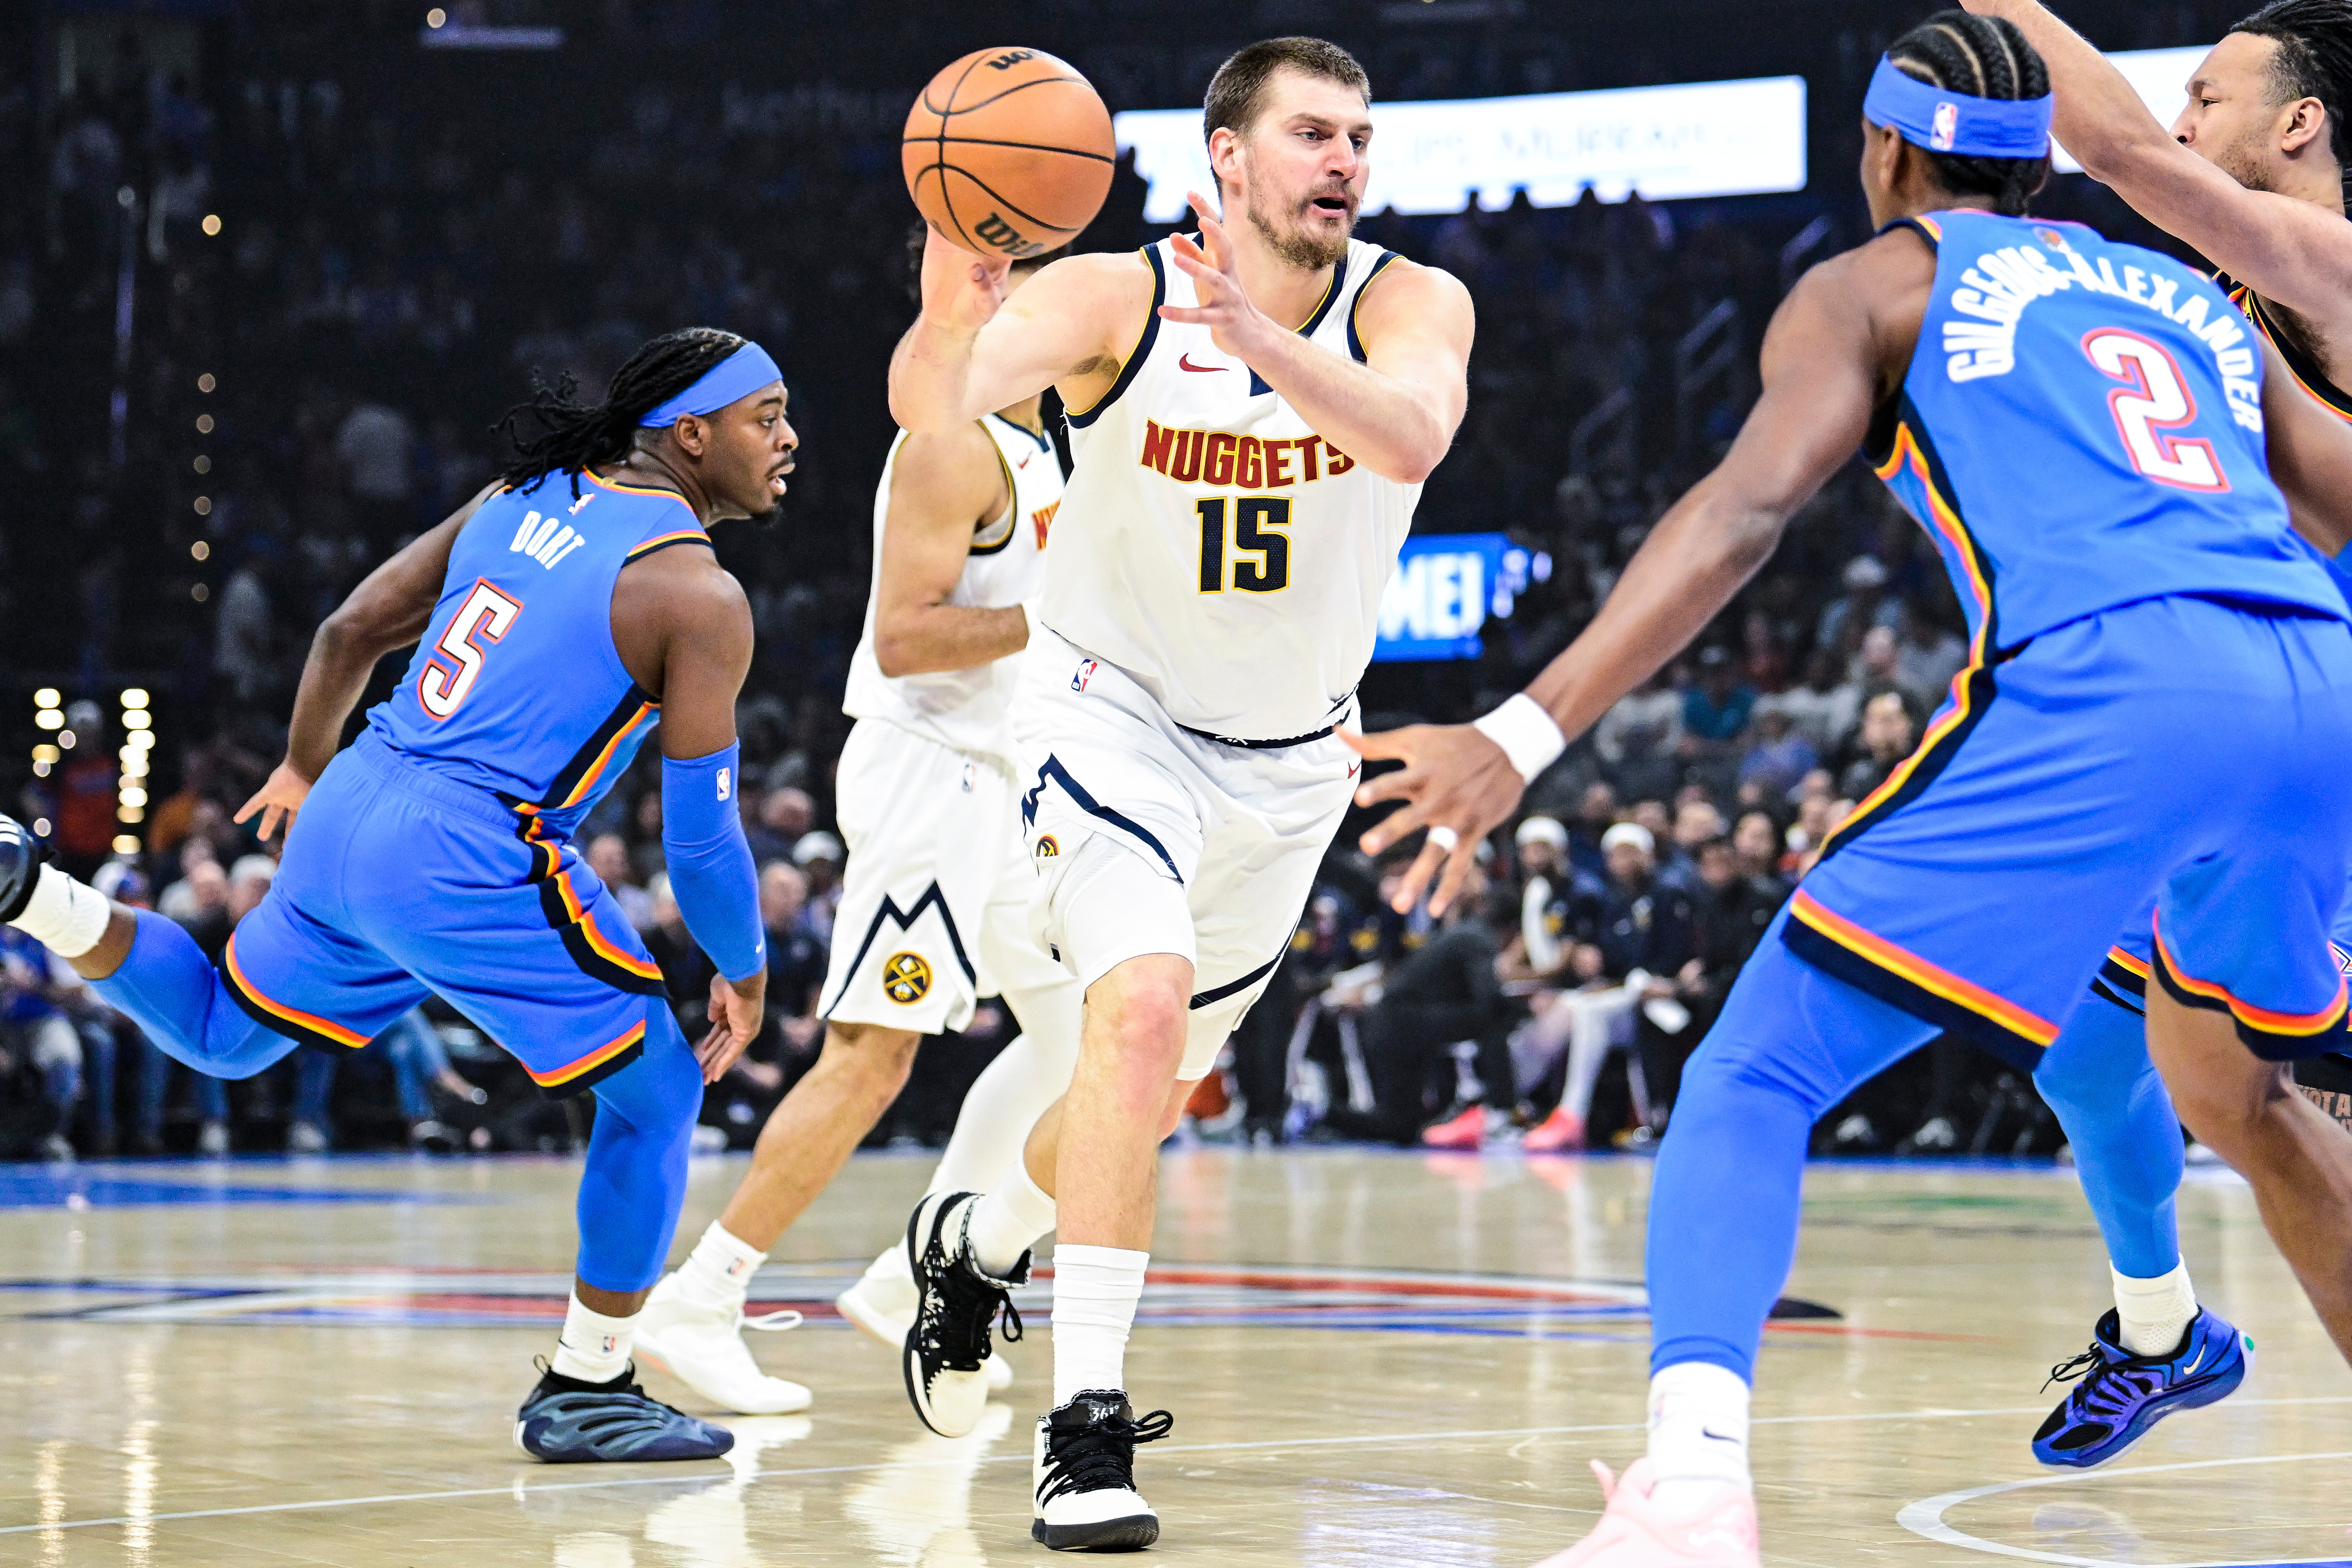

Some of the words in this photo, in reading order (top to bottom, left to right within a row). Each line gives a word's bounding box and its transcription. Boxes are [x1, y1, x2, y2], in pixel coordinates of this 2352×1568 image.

[1943, 245, 2264, 433] GILGEOUS-ALEXANDER
[1140, 417, 1357, 490] NUGGETS
[2081, 327, 2232, 493] 2
[509, 511, 585, 571] DORT
[1195, 496, 1293, 595] 15
[417, 576, 524, 721] 5
[2302, 1090, 2351, 1117] OTA
